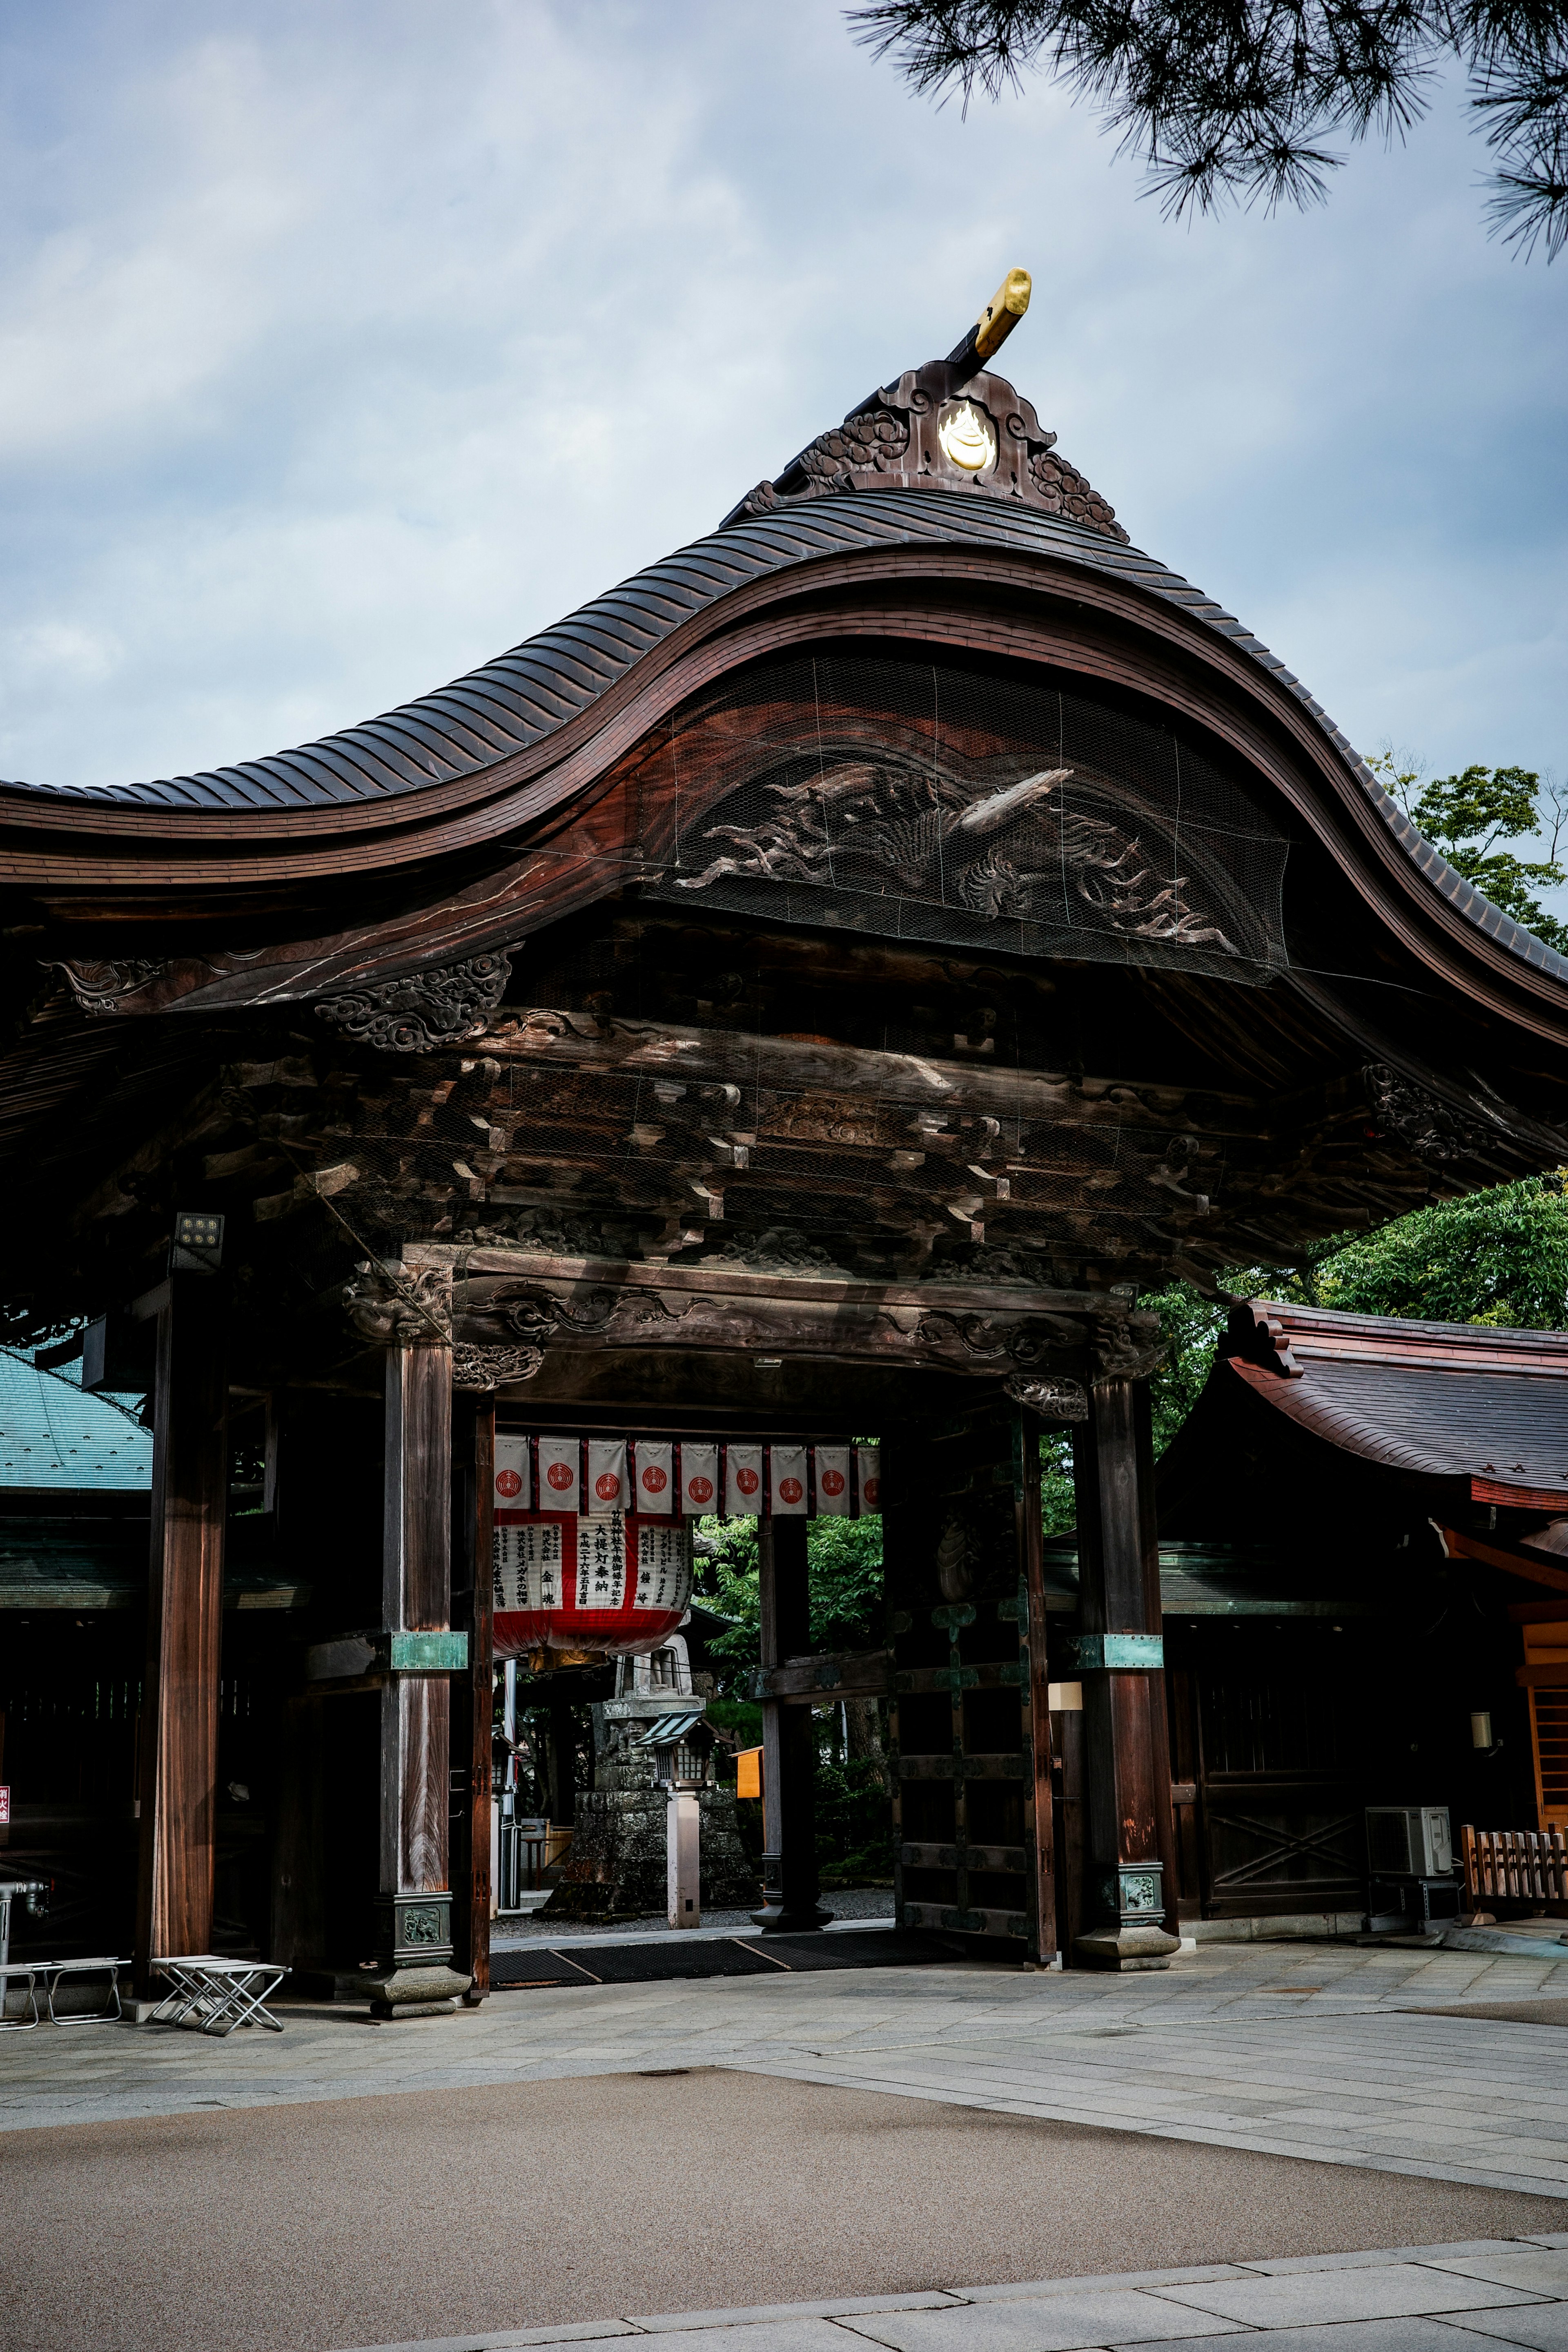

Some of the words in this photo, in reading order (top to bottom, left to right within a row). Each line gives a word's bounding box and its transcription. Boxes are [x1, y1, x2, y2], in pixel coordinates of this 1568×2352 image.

[579, 1533, 590, 1605] 平成二十六年五月吉日
[594, 1524, 609, 1592] 大提灯奉納
